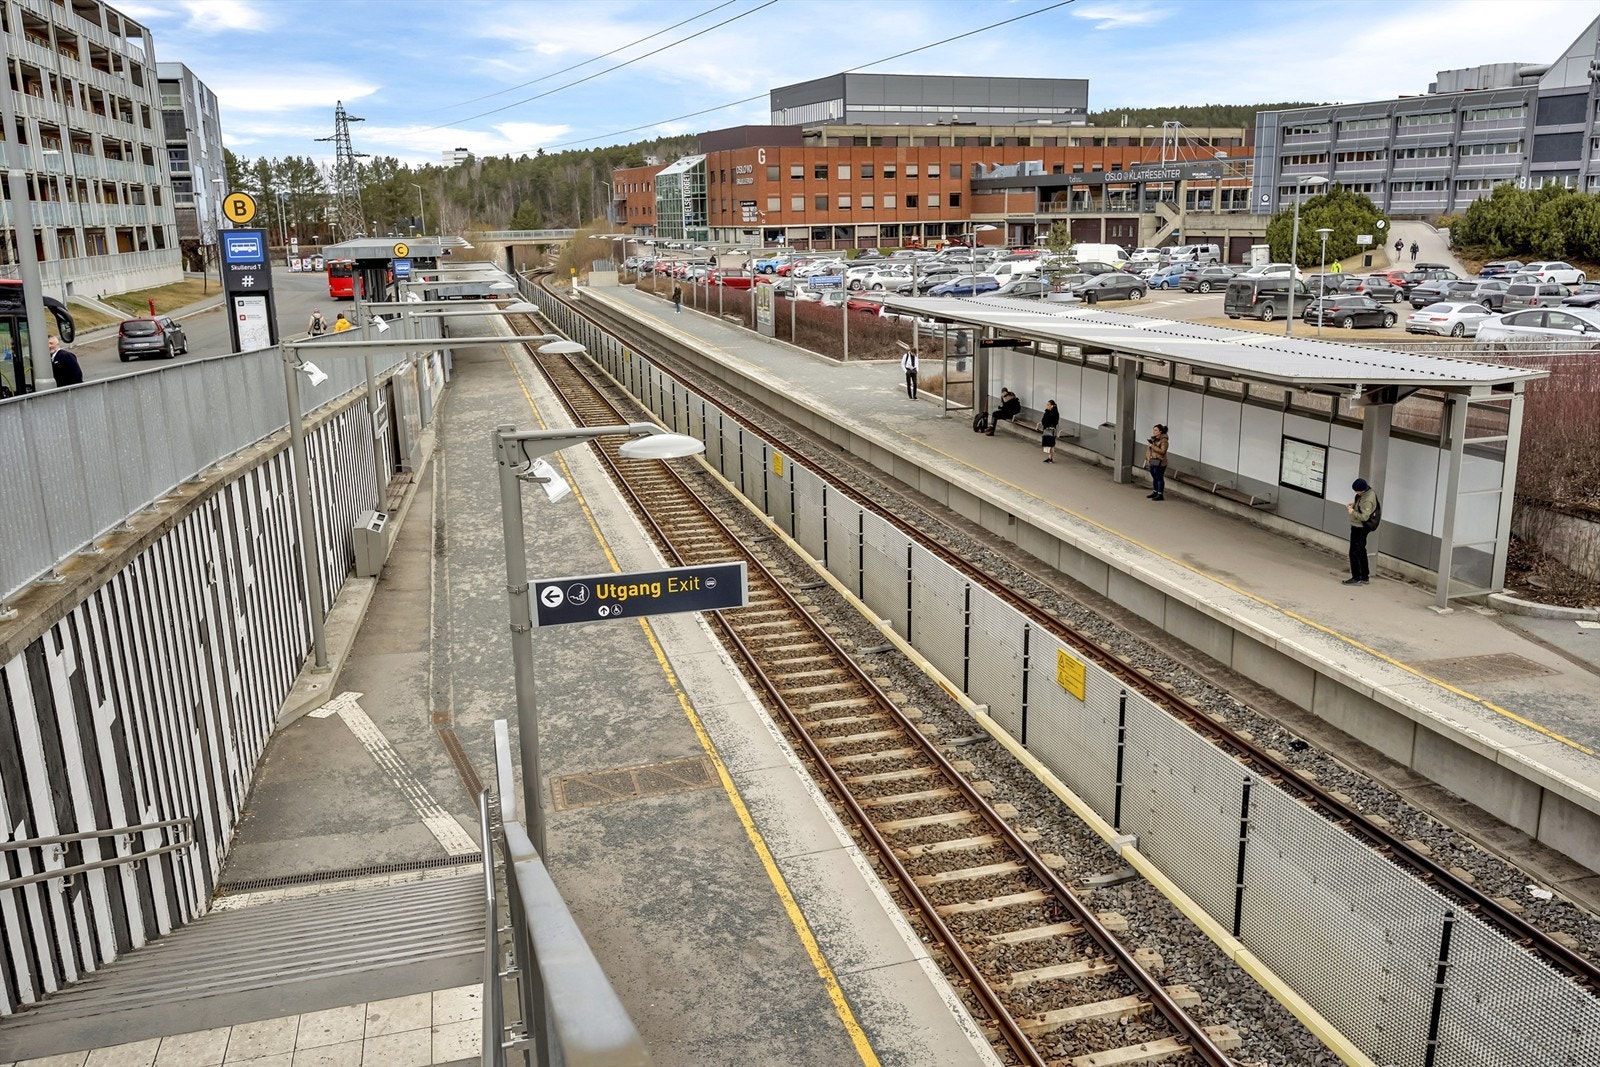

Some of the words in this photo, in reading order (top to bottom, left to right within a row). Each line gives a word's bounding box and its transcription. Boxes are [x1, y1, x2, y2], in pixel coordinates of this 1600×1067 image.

[758, 148, 766, 165] G
[1105, 172, 1122, 181] OSLO
[1129, 169, 1180, 180] KLATRESENTER
[683, 172, 692, 217] HELSETORGET
[233, 200, 247, 216] B
[397, 246, 404, 255] C
[596, 582, 661, 601] Utgang
[668, 575, 700, 593] Exit
